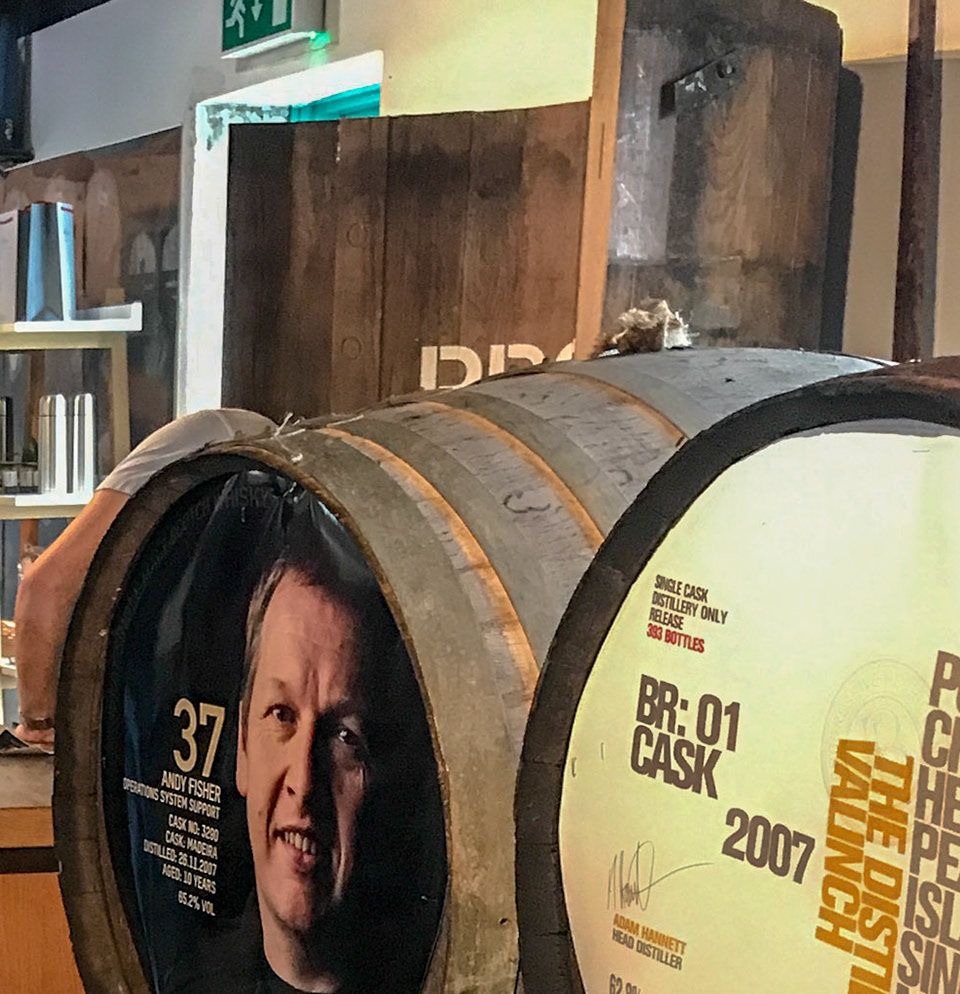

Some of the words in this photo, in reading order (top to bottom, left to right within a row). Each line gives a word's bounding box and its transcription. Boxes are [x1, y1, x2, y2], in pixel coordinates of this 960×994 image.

[655, 574, 682, 595] SINGLE
[683, 583, 709, 603] CASK
[649, 607, 684, 630] RELEASE
[652, 591, 698, 617] DISTILLERY
[701, 605, 728, 624] ONLY
[664, 629, 705, 653] BOTTLES
[929, 650, 960, 713] P
[636, 673, 689, 737] BR:
[696, 694, 740, 752] 01
[173, 698, 225, 778] 37
[631, 724, 722, 800] CASK
[161, 770, 187, 792] ANDY
[188, 777, 221, 803] FISHER
[160, 790, 188, 810] SYSTEM
[189, 798, 220, 820] SUPPORT
[866, 755, 914, 855] THE
[168, 813, 187, 831] CASK
[143, 838, 177, 863] DISTILLED:
[187, 837, 218, 860] MADEIRA
[721, 808, 815, 884] 2007
[815, 739, 875, 954] VALINCH
[183, 871, 192, 885] 10
[193, 874, 216, 895] YEARS
[201, 899, 216, 916] VOL
[612, 928, 634, 950] HEAD
[636, 939, 682, 970] DISTILLER
[613, 914, 639, 936] ADAM
[642, 926, 687, 955] HANNETT
